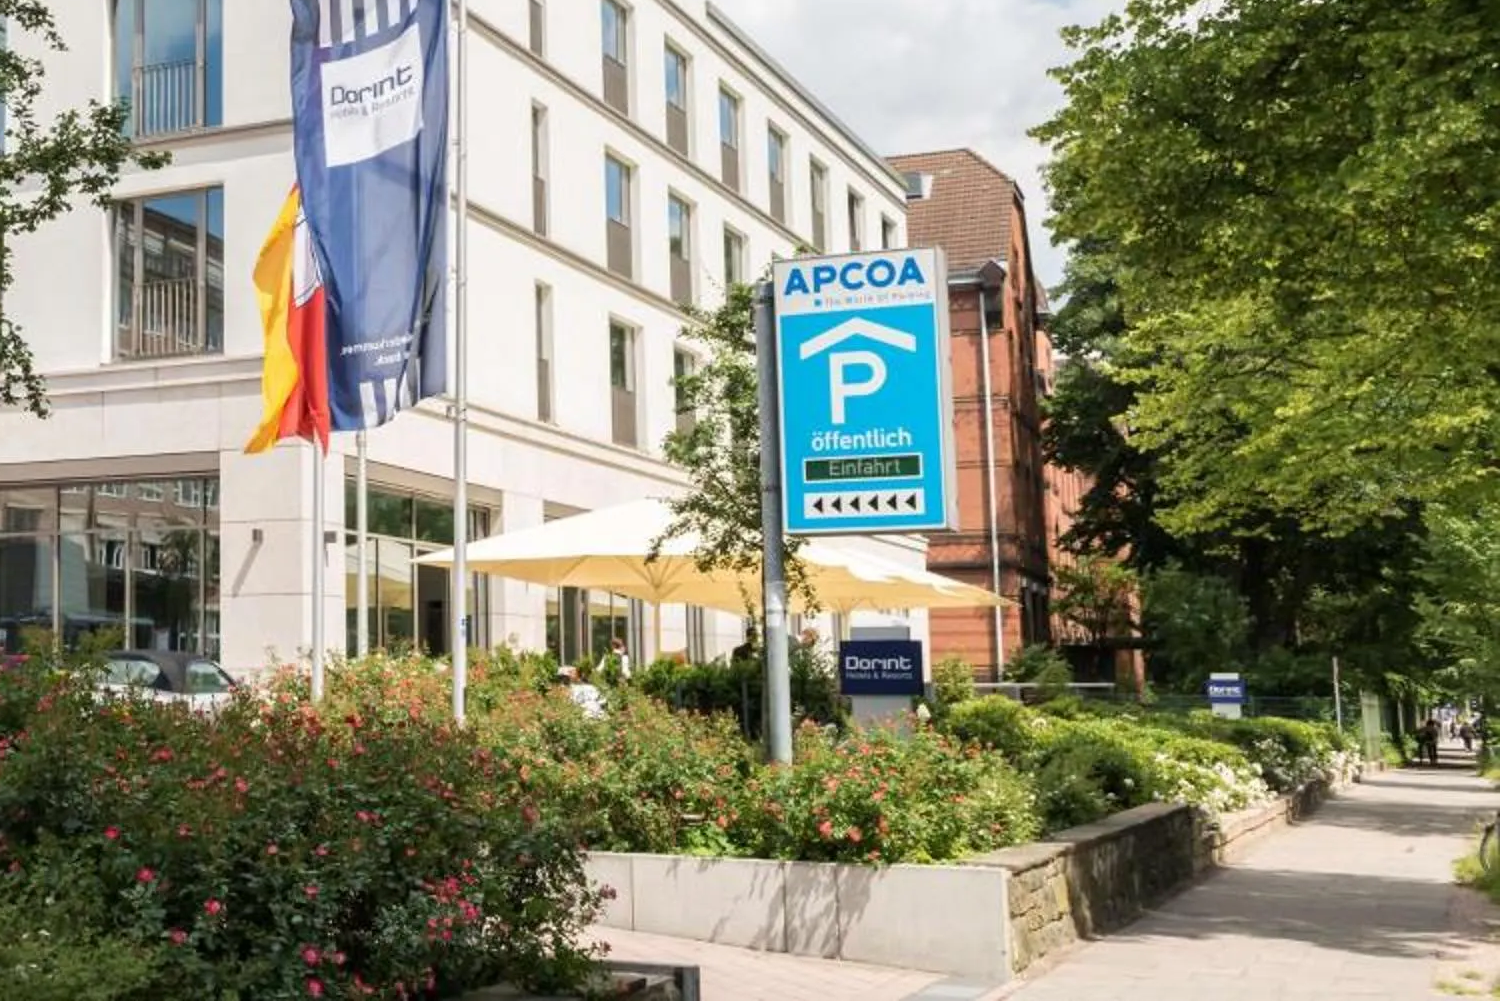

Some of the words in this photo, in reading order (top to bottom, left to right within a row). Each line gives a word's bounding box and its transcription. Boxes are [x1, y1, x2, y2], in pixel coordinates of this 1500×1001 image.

[331, 65, 413, 106] Dorint
[784, 256, 925, 296] APCOA
[829, 350, 887, 424] P
[811, 428, 912, 451] öffentlich
[829, 458, 900, 477] Einfahrt
[845, 654, 912, 670] Dorint
